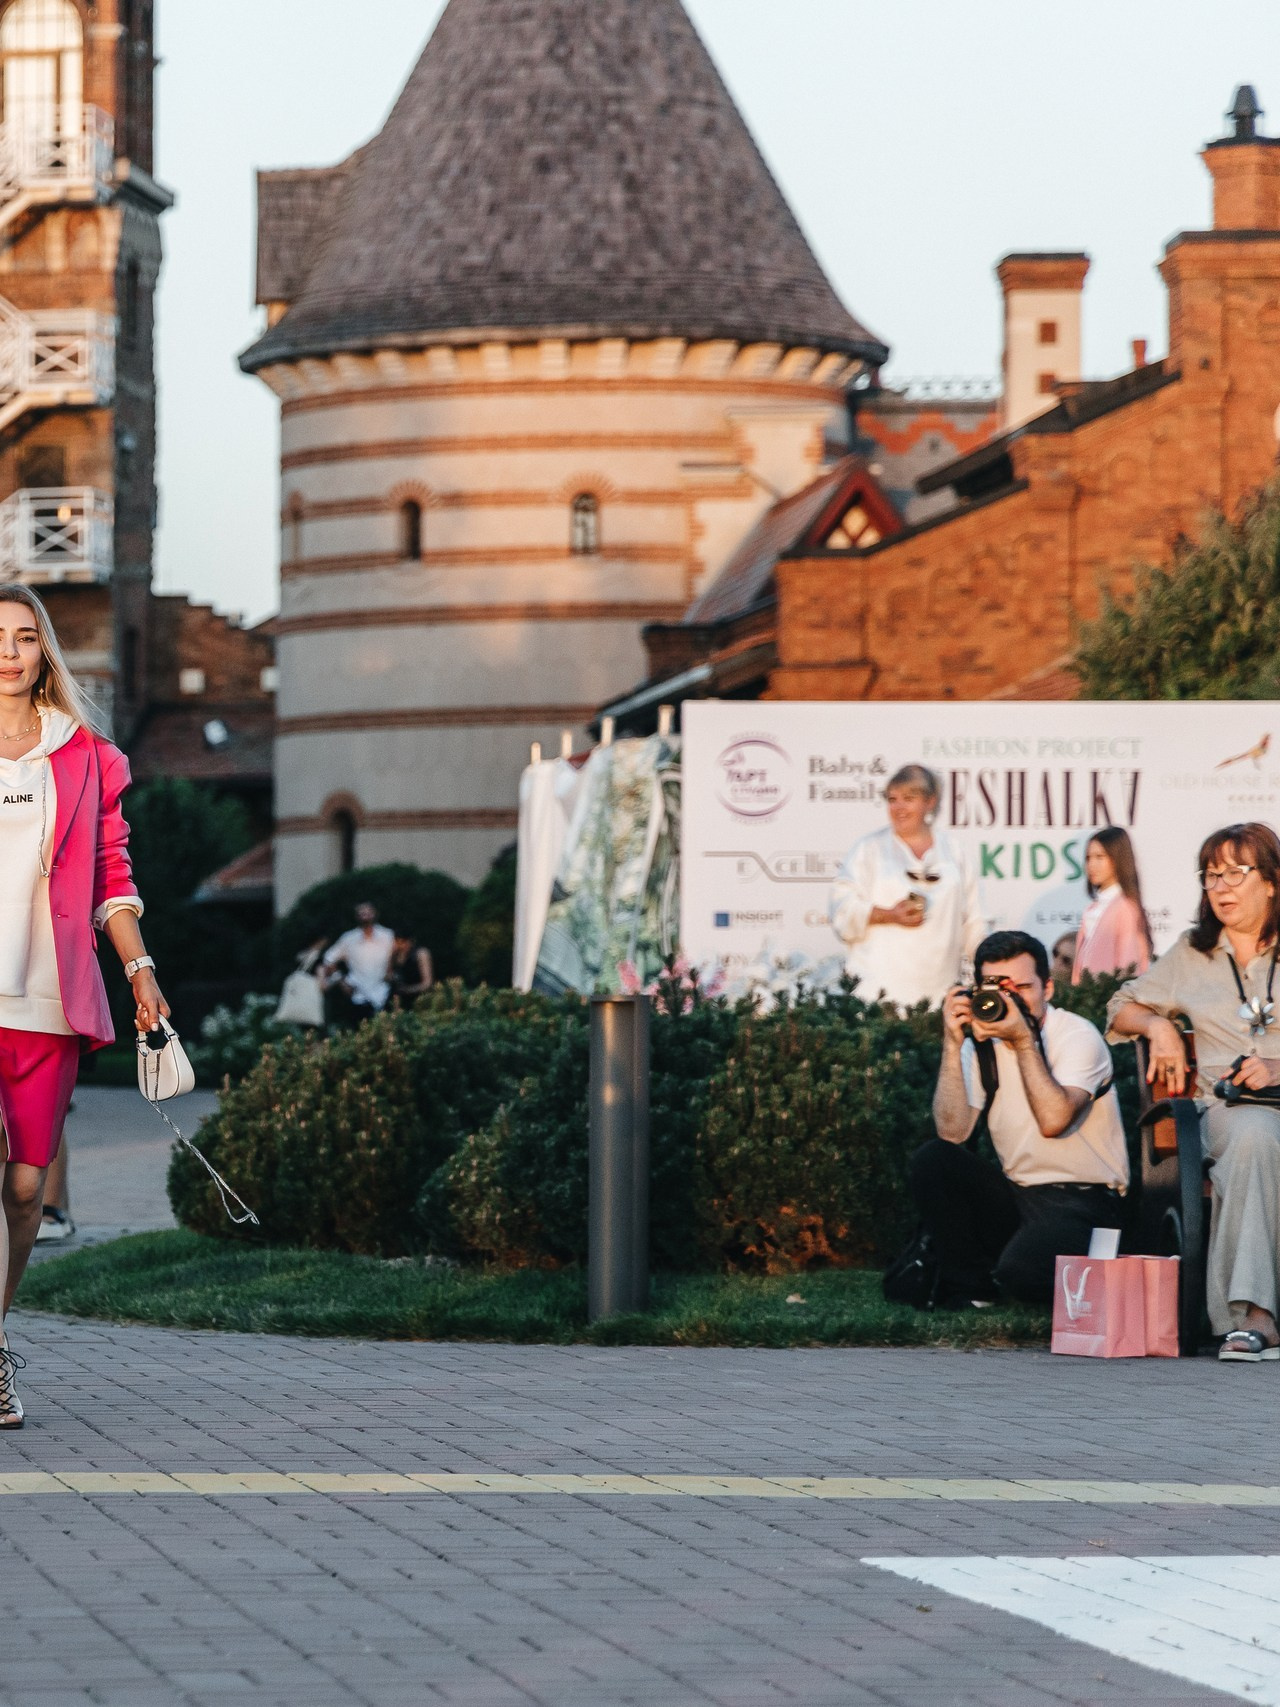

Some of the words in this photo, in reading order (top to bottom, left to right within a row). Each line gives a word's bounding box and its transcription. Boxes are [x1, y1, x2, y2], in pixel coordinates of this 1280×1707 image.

[921, 736, 1029, 759] FASHION
[1037, 736, 1143, 759] PROJECT
[808, 755, 864, 782] Baby
[2, 793, 34, 805] ALINE
[978, 840, 1085, 882] KIDS
